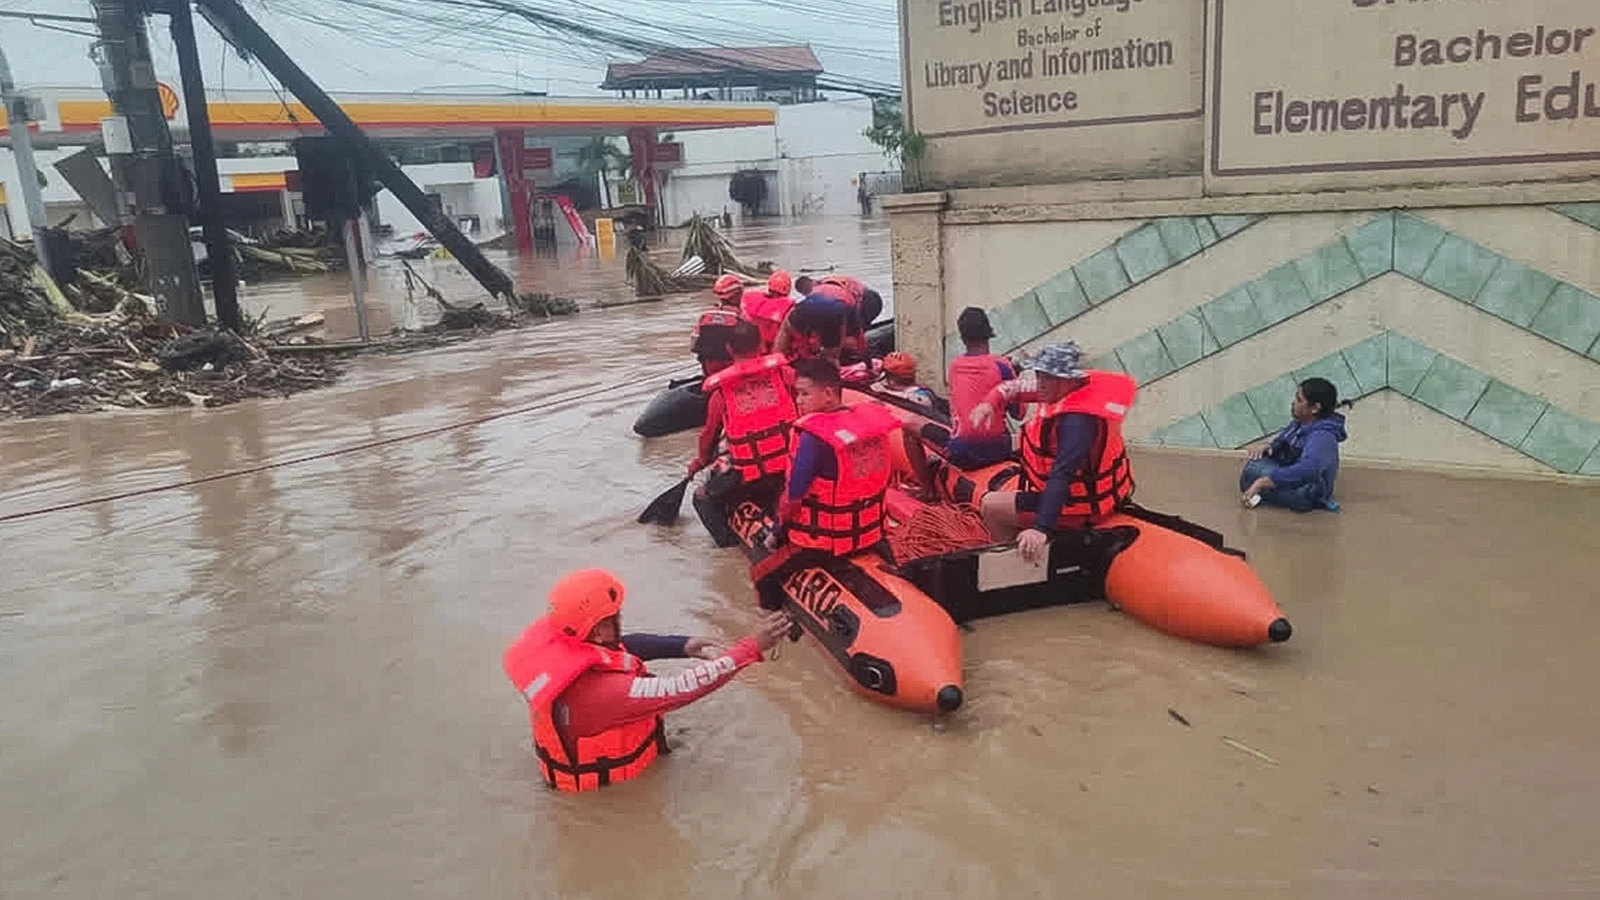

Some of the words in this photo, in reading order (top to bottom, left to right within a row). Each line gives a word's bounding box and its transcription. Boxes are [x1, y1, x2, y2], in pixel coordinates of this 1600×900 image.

[938, 0, 1022, 33] English
[1017, 27, 1080, 47] Bachelor
[1085, 18, 1102, 38] of
[925, 60, 992, 89] Library
[997, 53, 1033, 81] and
[1042, 37, 1173, 77] Information
[1394, 25, 1596, 67] Bachelor
[983, 89, 1079, 117] Science
[1253, 82, 1486, 140] Elementary
